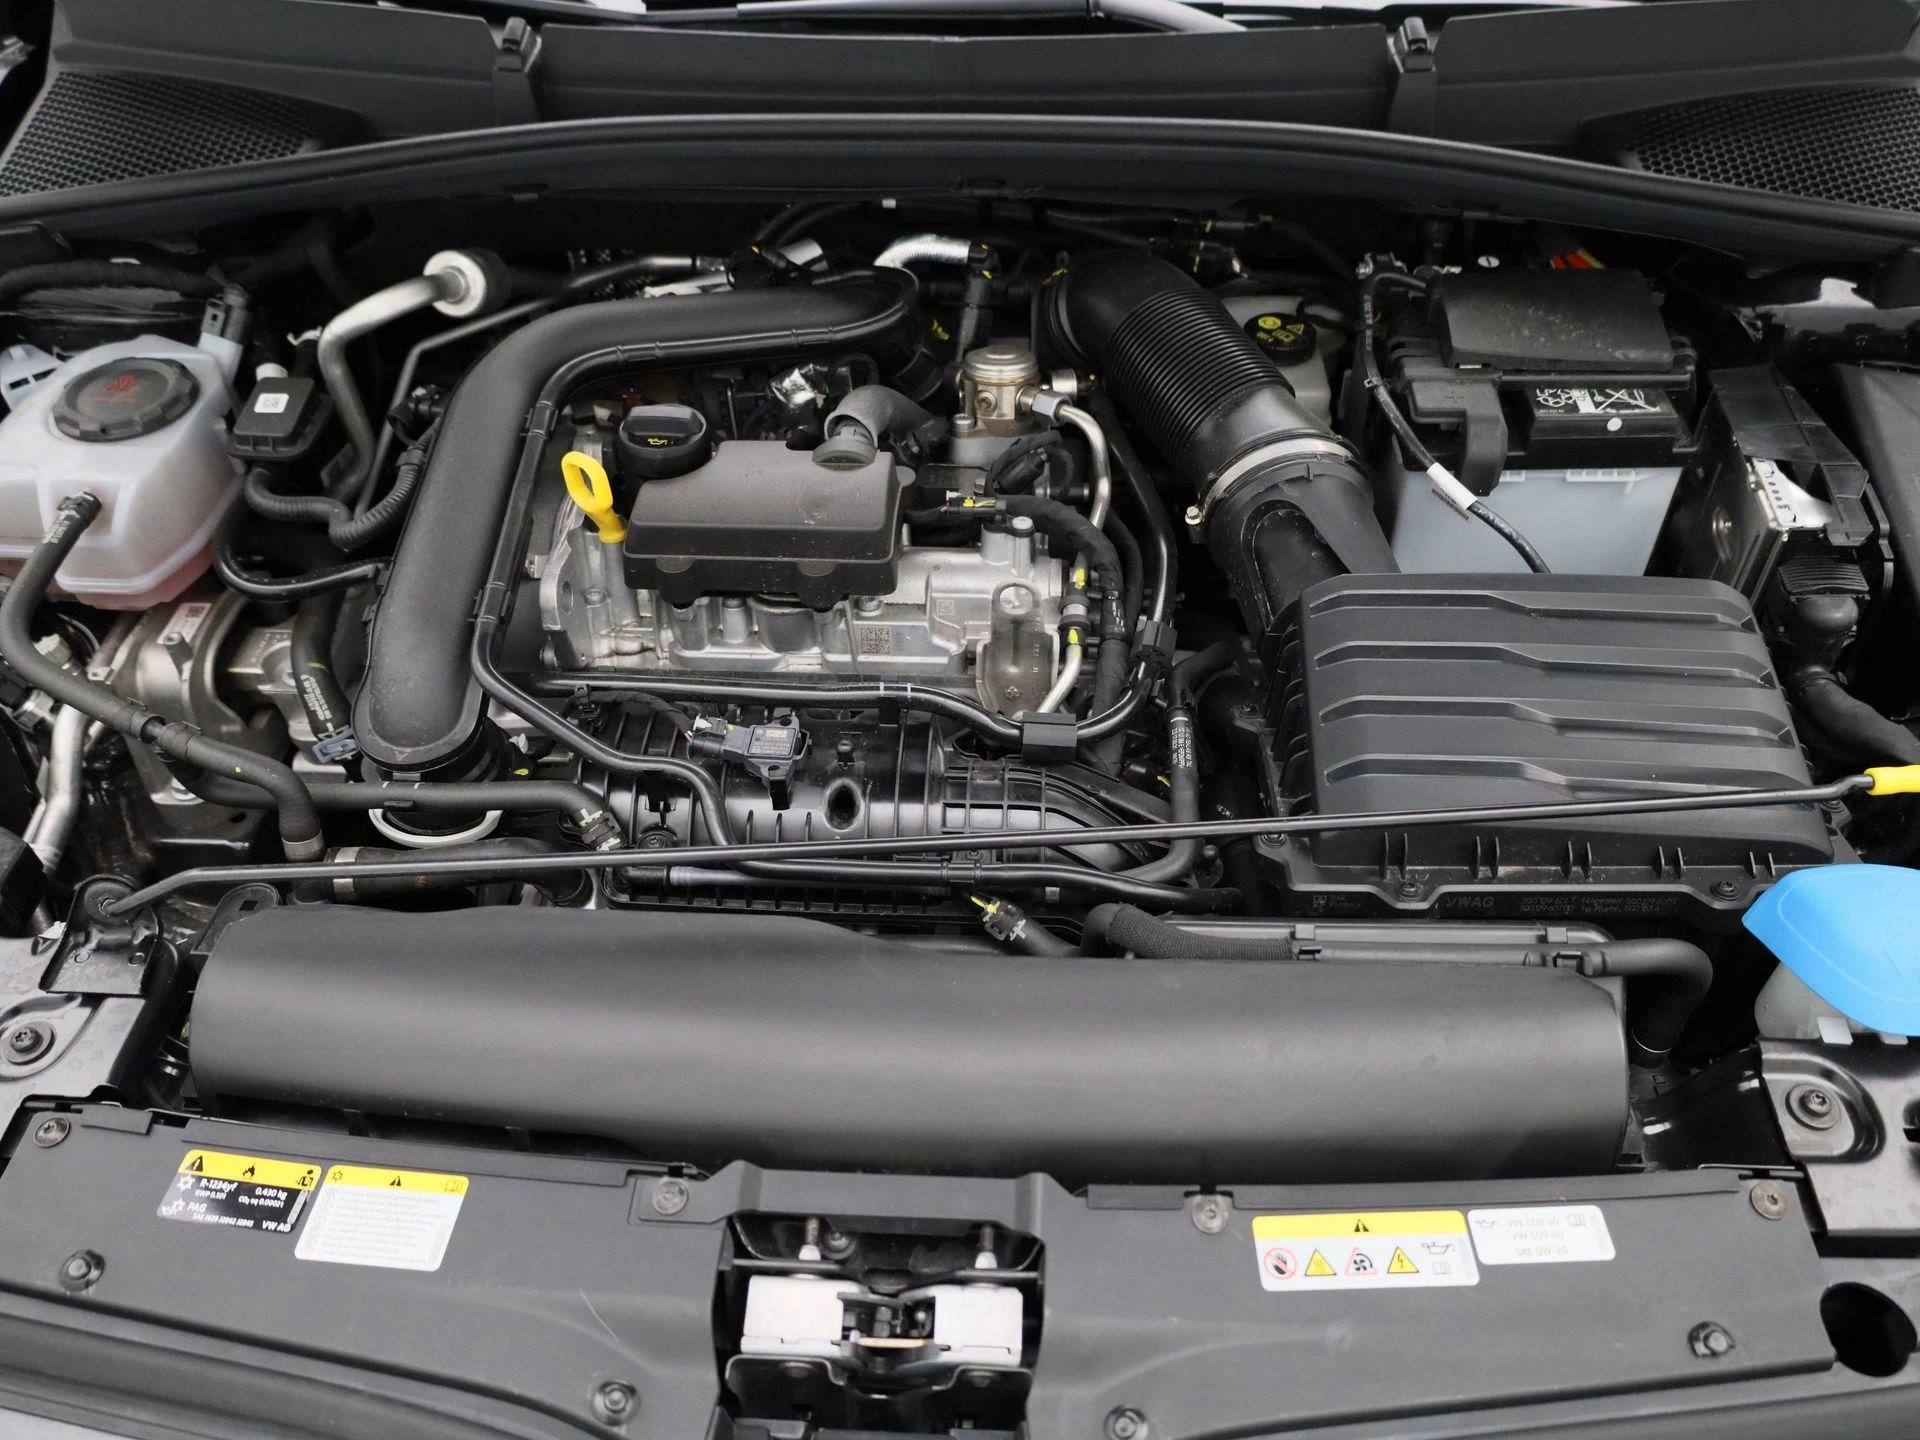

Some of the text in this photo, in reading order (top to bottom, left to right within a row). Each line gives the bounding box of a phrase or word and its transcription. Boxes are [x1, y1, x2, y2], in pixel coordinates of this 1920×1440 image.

[200, 1178, 238, 1193] R-1234yf
[255, 1187, 287, 1200] 0.430 kg
[187, 1202, 207, 1213] PAG
[262, 1220, 291, 1232] VW AG
